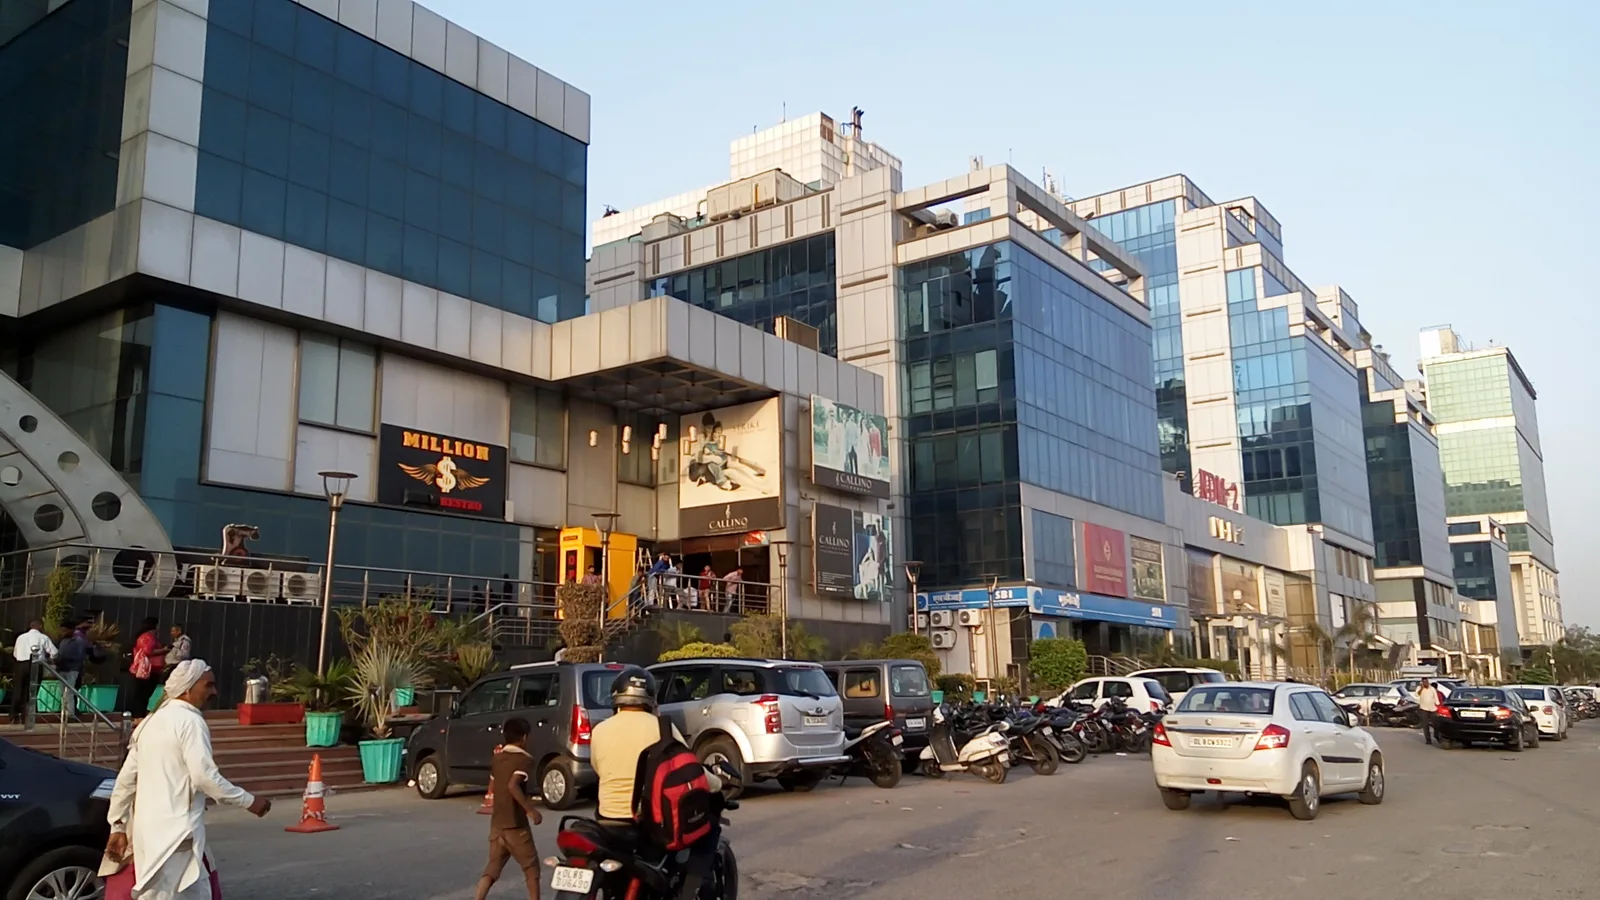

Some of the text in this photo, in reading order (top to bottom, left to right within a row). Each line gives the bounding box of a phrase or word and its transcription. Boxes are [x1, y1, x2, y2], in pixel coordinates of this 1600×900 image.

[403, 431, 489, 461] MILLION
[840, 473, 872, 489] CALLINO
[709, 517, 748, 529] CALLINO
[819, 535, 850, 548] CALLINO
[995, 590, 1013, 600] SBI
